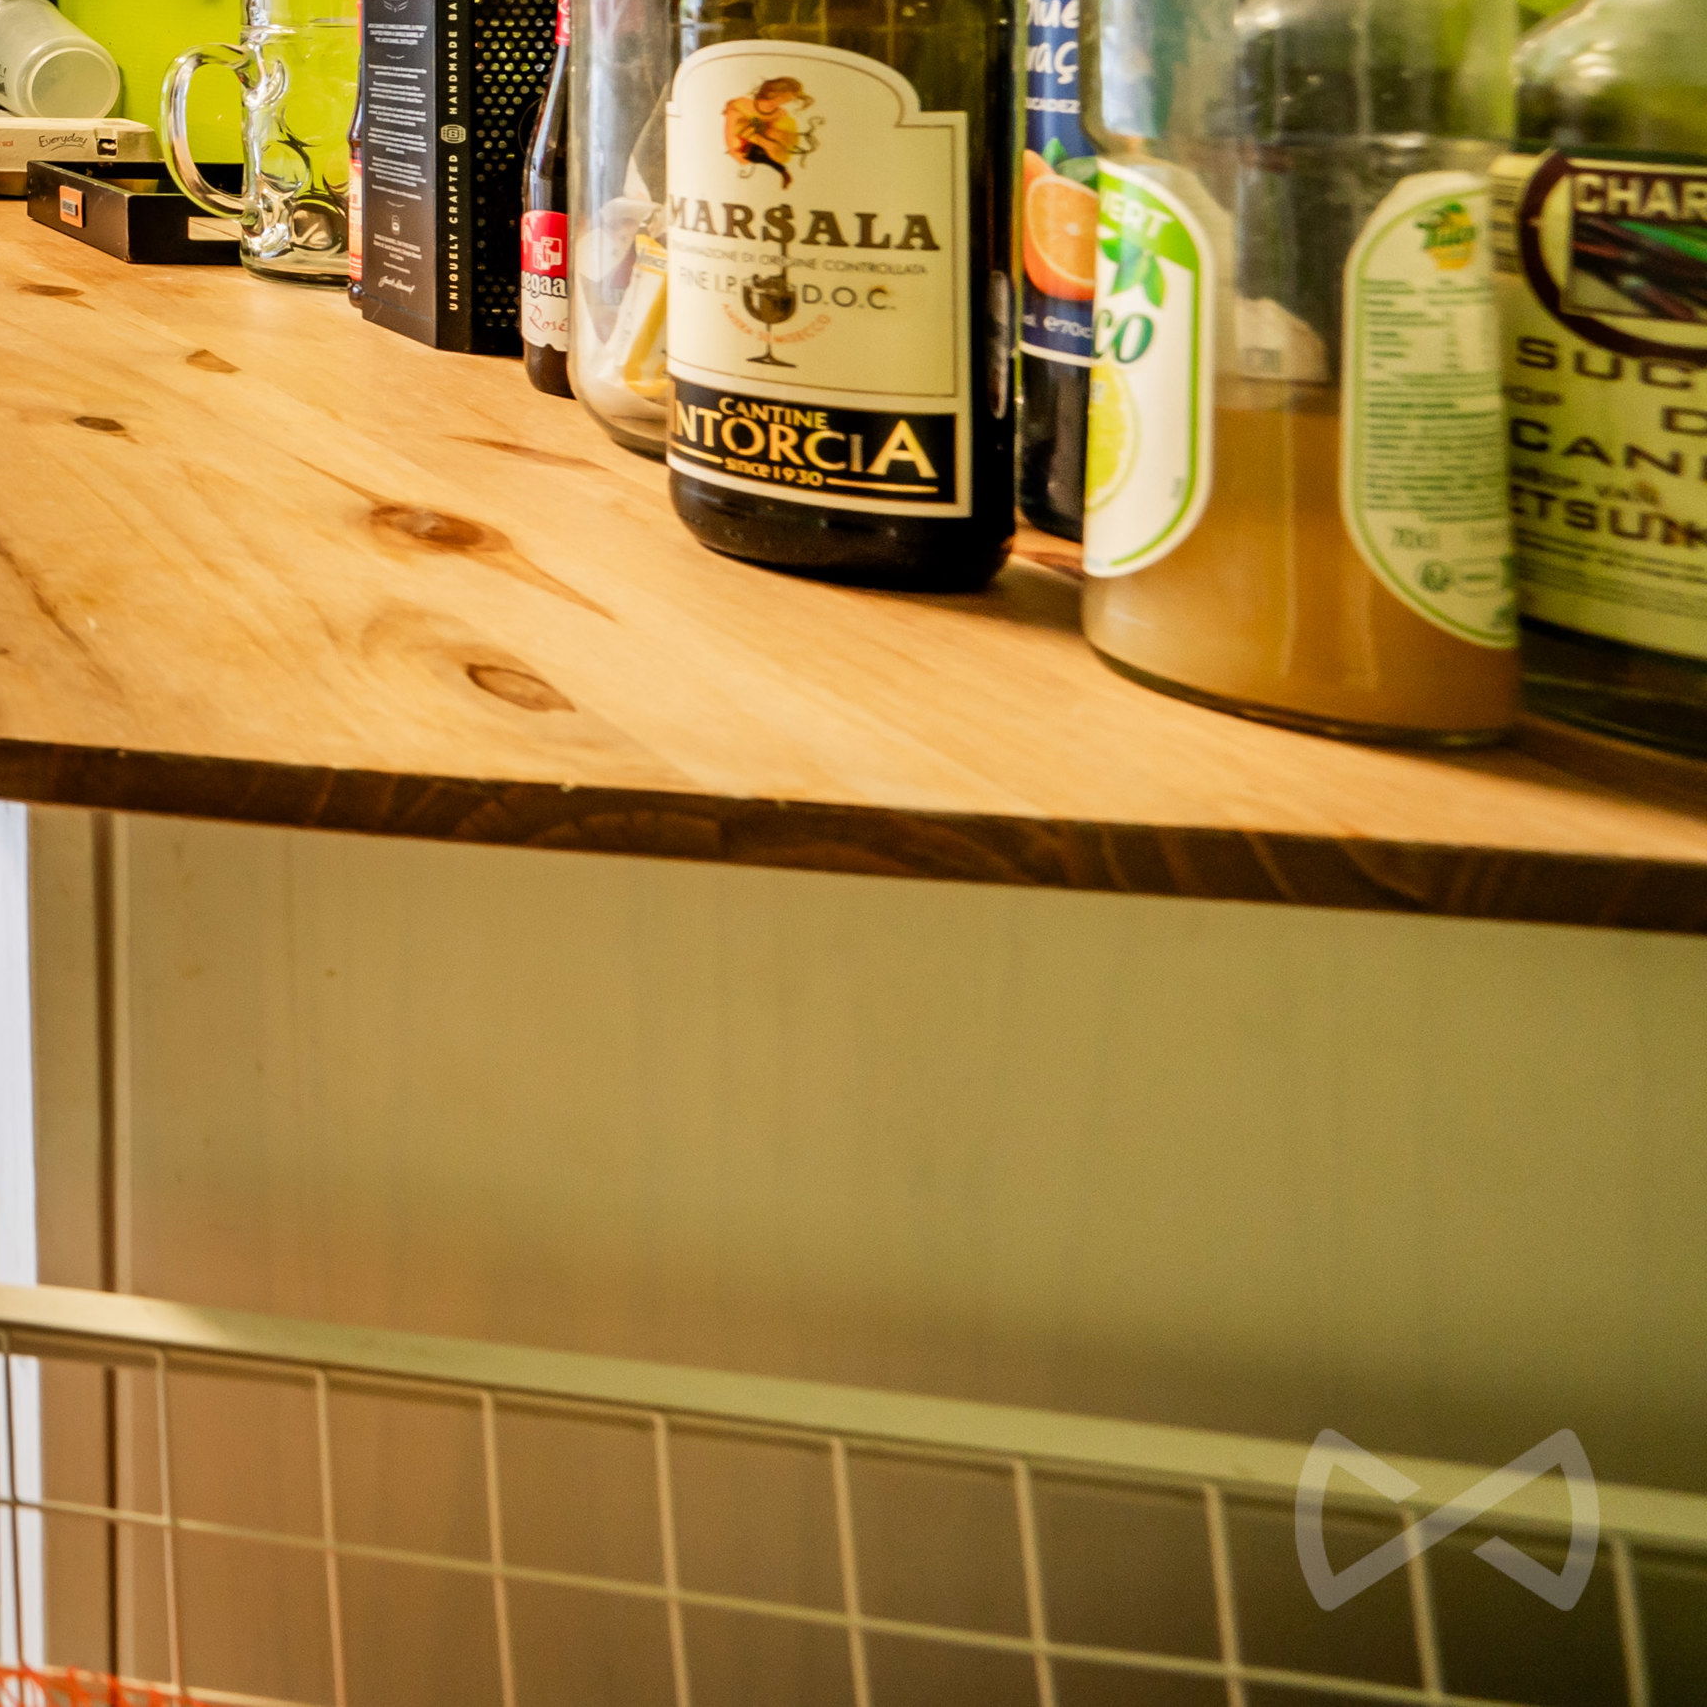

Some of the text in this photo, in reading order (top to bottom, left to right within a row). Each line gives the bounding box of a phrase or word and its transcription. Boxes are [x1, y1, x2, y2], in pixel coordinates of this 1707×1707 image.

[448, 30, 459, 115] HANDMADE
[38, 133, 88, 149] Everyday
[448, 154, 459, 223] CRAFTED
[668, 194, 941, 251] MARSALA
[448, 234, 459, 311] UNIQUELY
[719, 396, 829, 430] CANTINE
